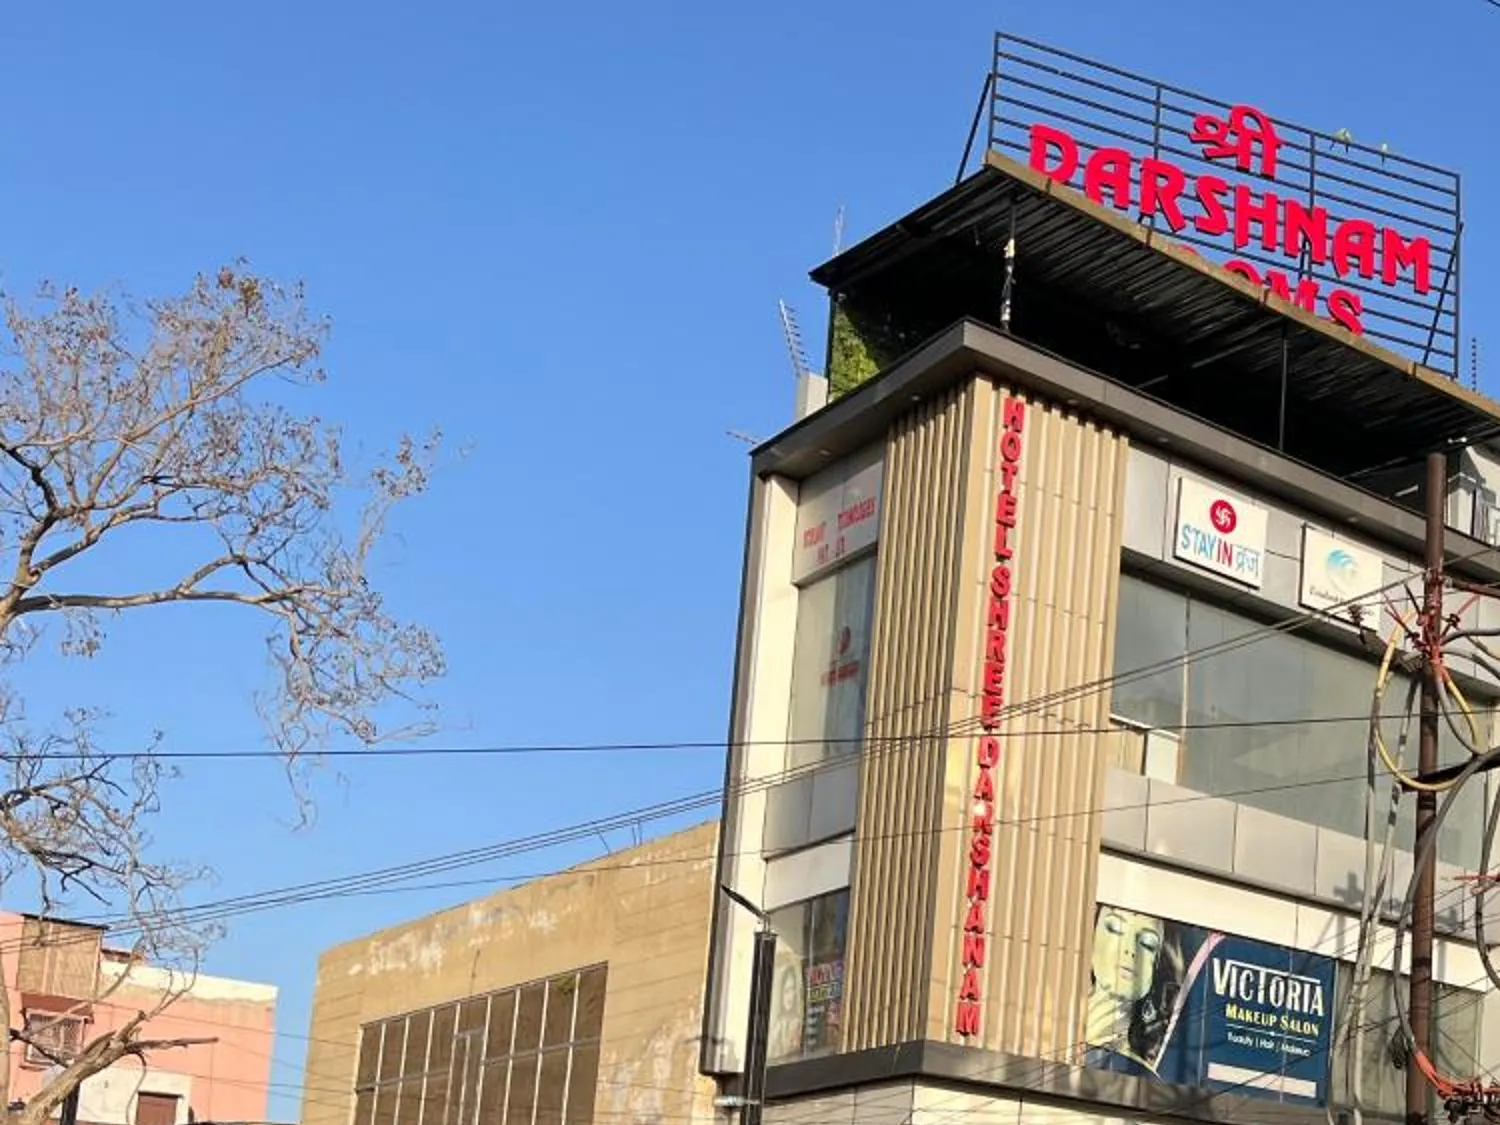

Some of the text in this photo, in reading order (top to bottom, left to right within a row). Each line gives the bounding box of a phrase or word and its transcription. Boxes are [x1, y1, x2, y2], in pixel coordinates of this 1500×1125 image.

[1189, 104, 1285, 180] श्री
[1028, 124, 1431, 294] DARSHNAM
[995, 397, 1026, 562] HOTEL
[981, 564, 1011, 729] SHREE
[1212, 958, 1325, 1018] VICTORIA
[1225, 1003, 1320, 1036] MAKEUP SALON
